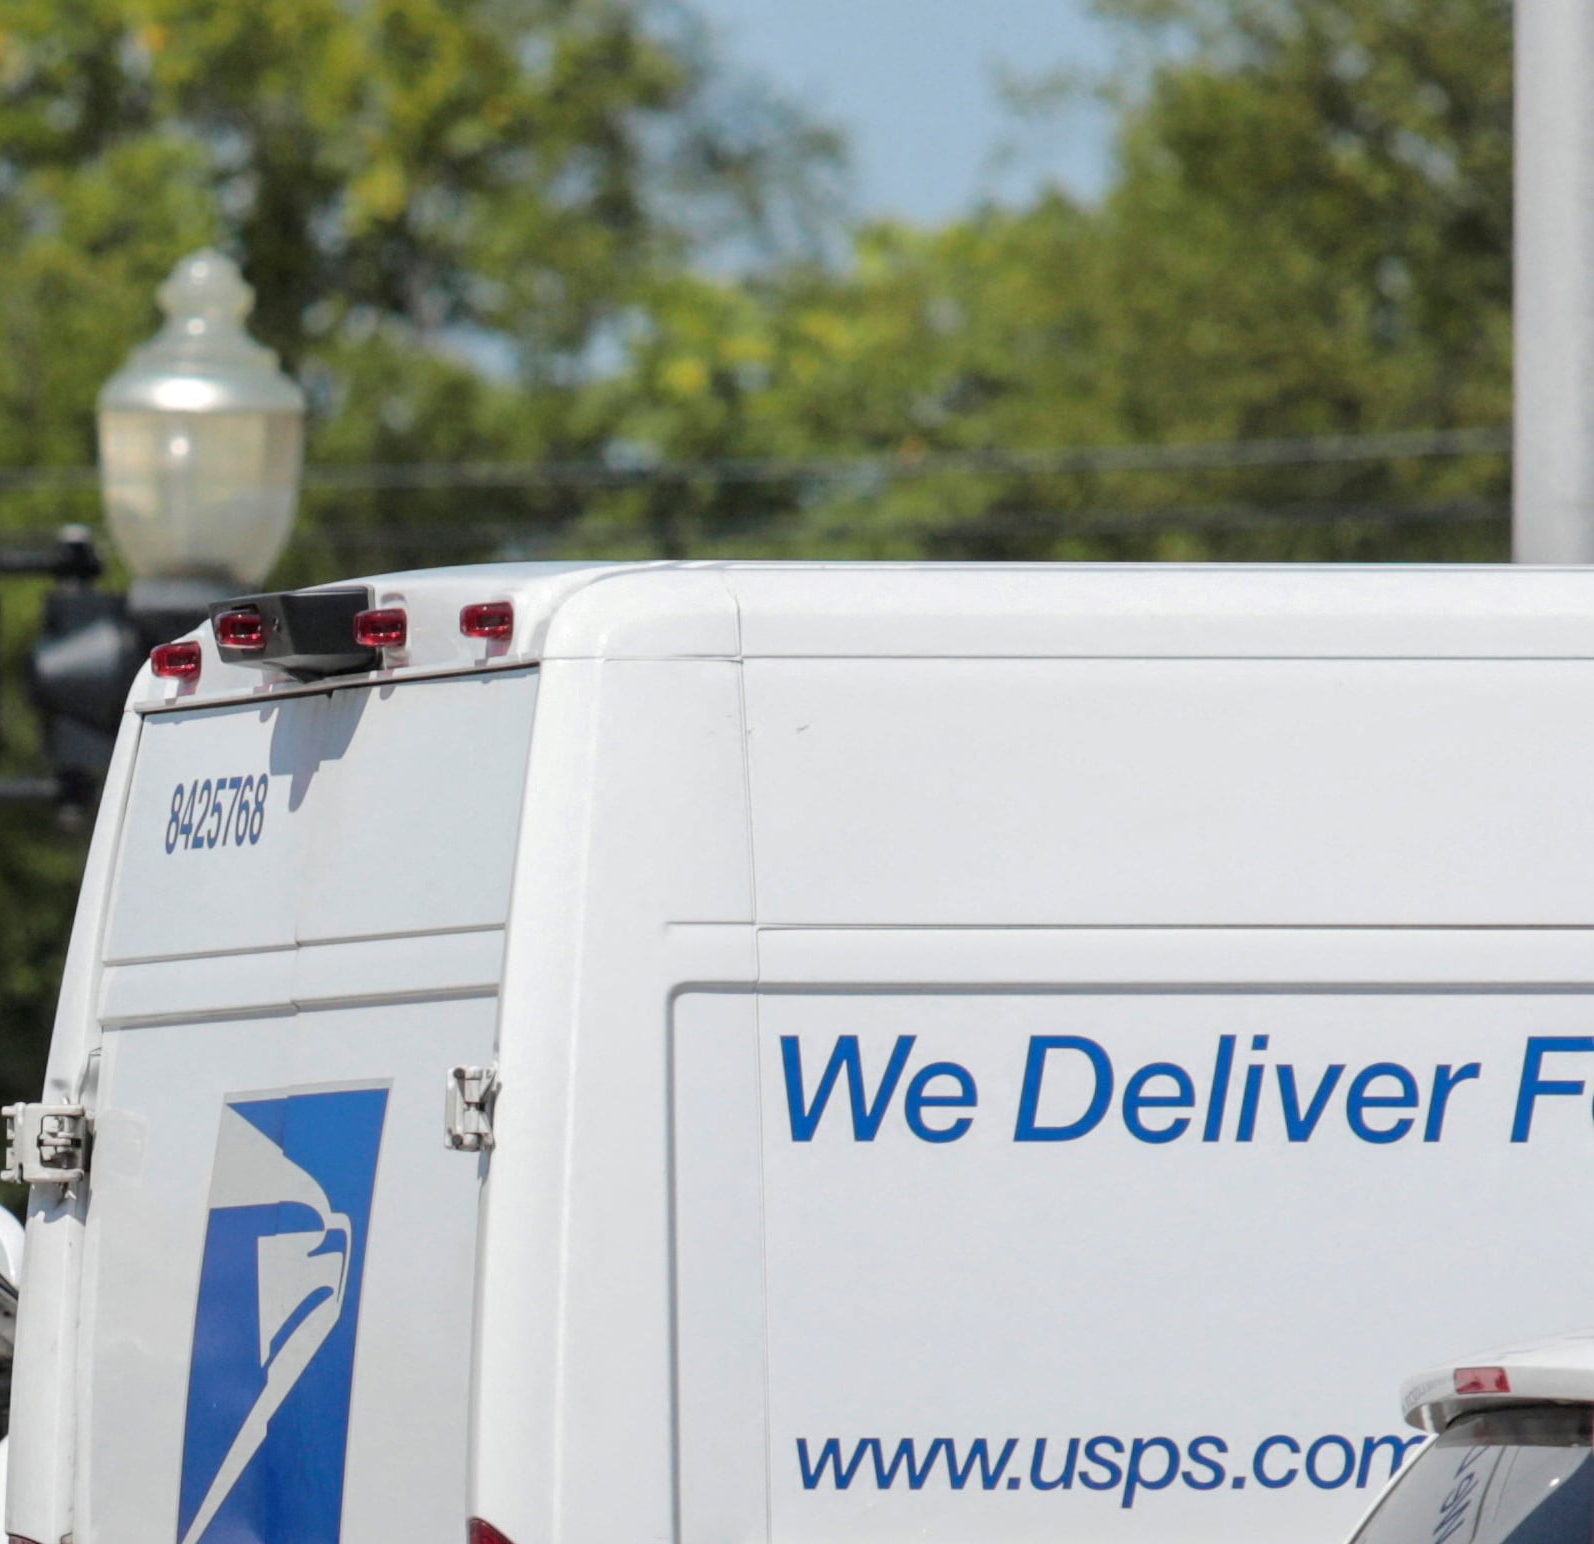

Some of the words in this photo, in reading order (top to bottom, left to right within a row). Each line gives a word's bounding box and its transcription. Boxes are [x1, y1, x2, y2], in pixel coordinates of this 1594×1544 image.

[165, 773, 268, 855] 8425768
[779, 1035, 977, 1143] We
[1013, 1034, 1480, 1143] Deliver
[1510, 1036, 1594, 1142] F
